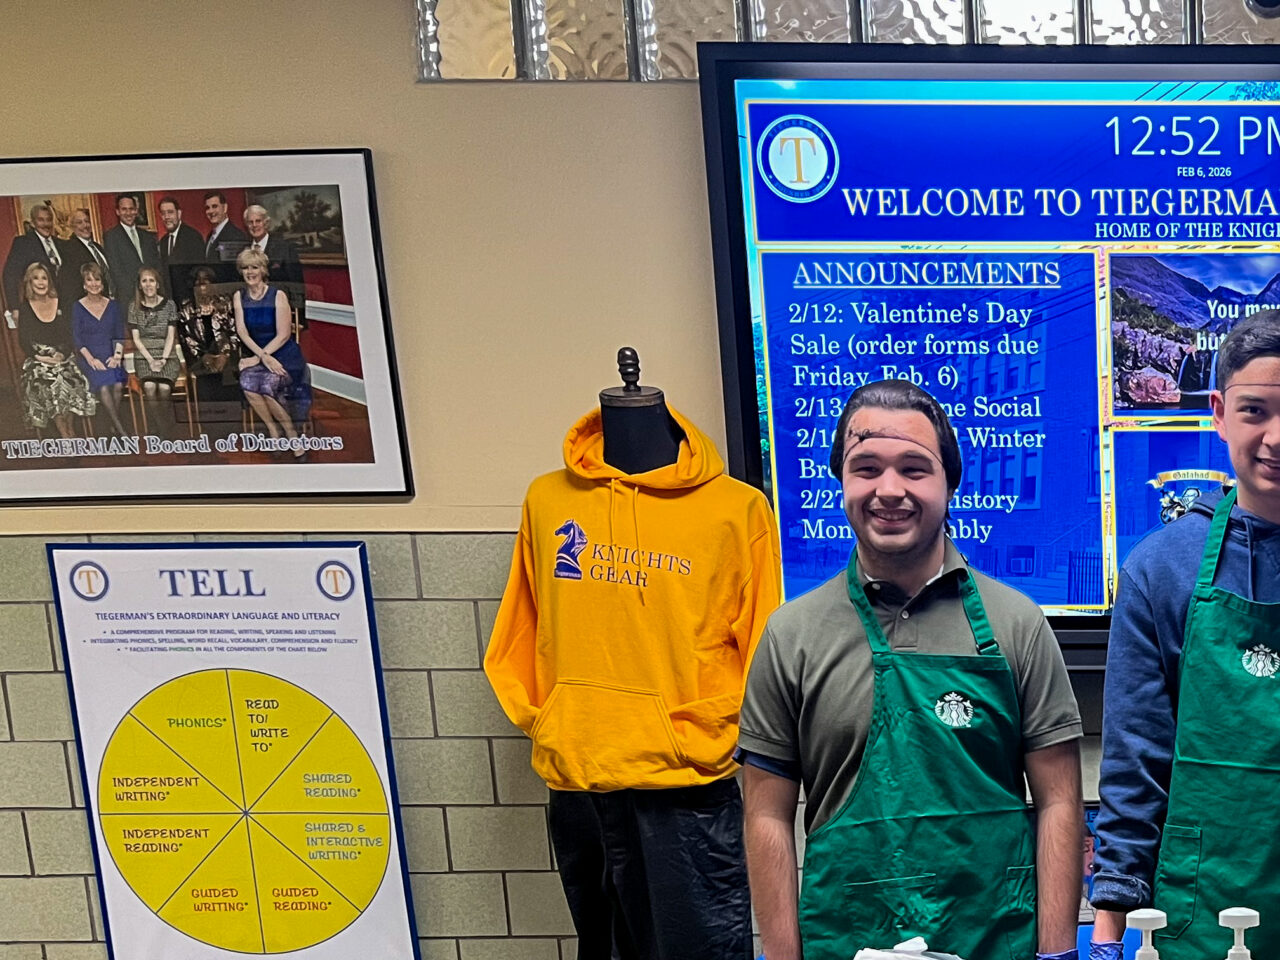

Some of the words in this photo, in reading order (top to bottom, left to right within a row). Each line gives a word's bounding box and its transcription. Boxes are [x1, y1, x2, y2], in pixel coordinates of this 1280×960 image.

[1106, 115, 1221, 156] 12:52
[779, 137, 817, 183] T
[1177, 167, 1195, 177] FEB
[1197, 167, 1206, 178] 6,
[1208, 167, 1231, 177] 2026
[842, 188, 1024, 216] WELCOME
[1035, 188, 1081, 216] TO
[1095, 223, 1151, 238] HOME
[1156, 223, 1180, 238] OF
[1185, 223, 1224, 238] THE
[793, 262, 1061, 286] ANNOUNCEMENTS
[788, 303, 843, 324] 2/12:
[850, 302, 978, 324] Valentine's
[986, 302, 1032, 327] Day
[1207, 300, 1239, 318] You
[791, 334, 839, 355] Sale
[848, 333, 917, 358] (order
[924, 334, 990, 355] forms
[997, 334, 1039, 355] due
[938, 366, 958, 390] 6)
[974, 397, 1041, 417] Social
[2, 434, 140, 459] TIEGERMAN
[144, 433, 210, 455] Board
[215, 431, 239, 453] of
[242, 431, 343, 454] Directors
[967, 428, 1046, 448] Winter
[951, 490, 1018, 513] istory
[78, 570, 98, 594] T
[159, 569, 266, 597] TELL
[325, 569, 346, 595] T
[590, 564, 648, 587] GEAR
[95, 612, 155, 620] TIEGERMAN'S
[157, 612, 230, 620] EXTRAORDINARY
[232, 612, 279, 620] LANGUAGE
[281, 612, 300, 620] AND
[302, 612, 341, 620] LITERACY
[245, 700, 279, 709] READ
[250, 728, 289, 738] WRITE
[112, 777, 200, 787] INDEPENDENT
[303, 774, 352, 783] SHARED
[122, 829, 210, 839] INDEPENDENT
[304, 823, 353, 832] SHARED
[306, 836, 384, 846] INTERACTIVE
[191, 888, 238, 898] GUIDED
[272, 888, 318, 897] GUIDED
